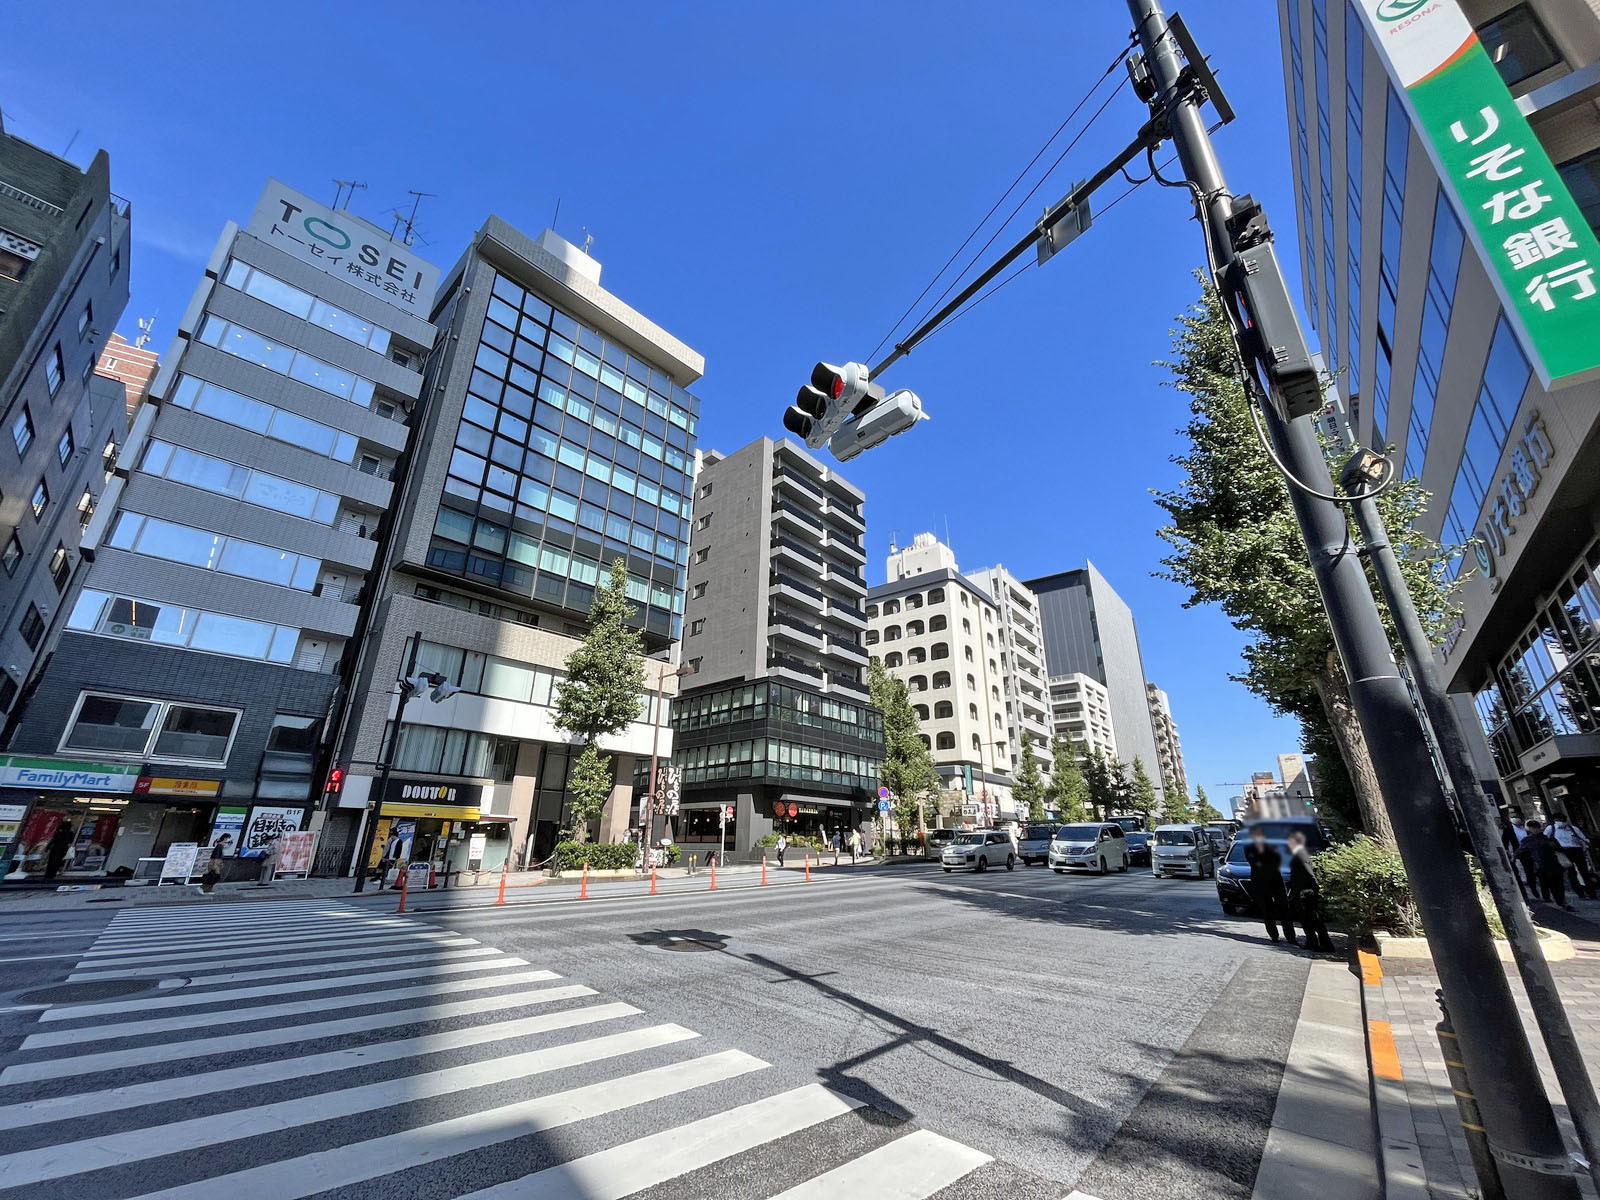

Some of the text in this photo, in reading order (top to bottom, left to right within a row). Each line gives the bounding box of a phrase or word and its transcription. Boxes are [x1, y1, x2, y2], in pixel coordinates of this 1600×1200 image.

[1389, 2, 1442, 35] RESONA
[1449, 105, 1597, 312] りそな銀行
[270, 223, 416, 305] トーセイ株式会社
[279, 198, 423, 290] TOSEI
[1484, 410, 1554, 557] りそな銀行
[17, 769, 111, 787] FamilyMart
[402, 784, 457, 801] DOUTOR
[253, 819, 297, 832] 目利きの
